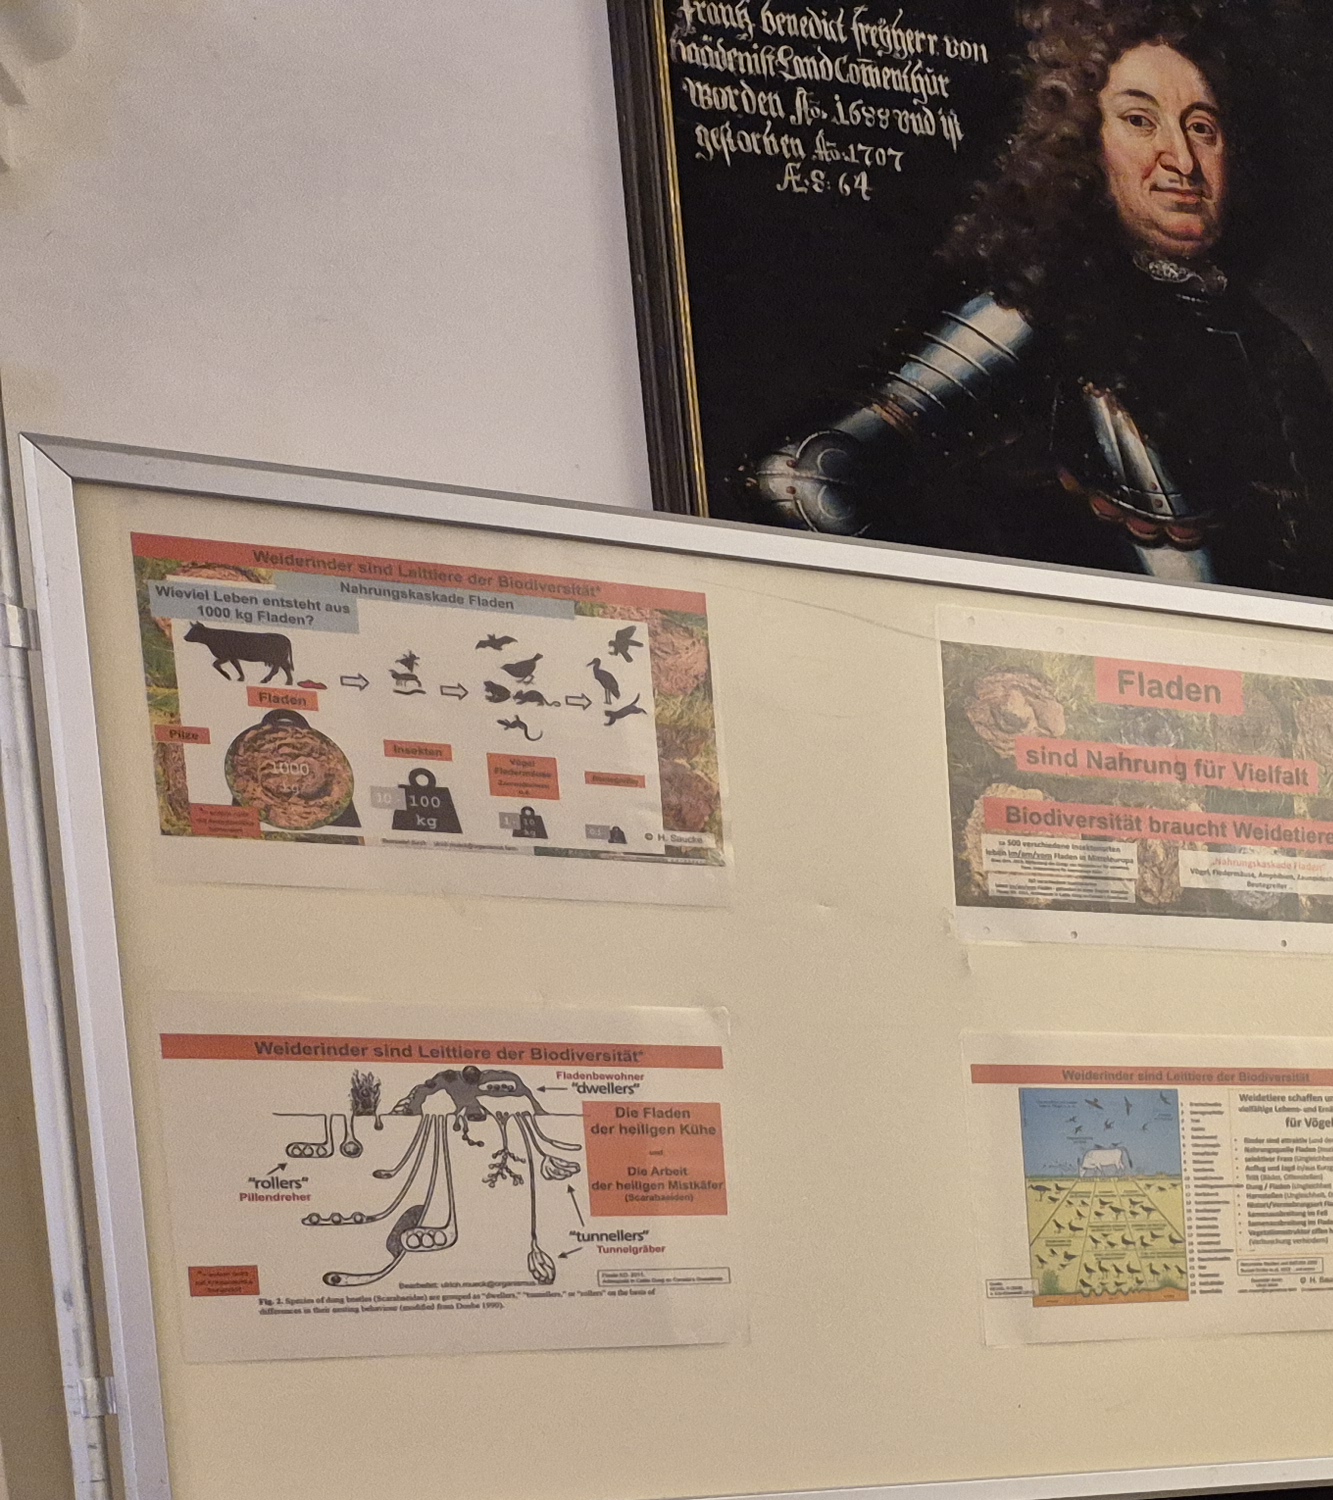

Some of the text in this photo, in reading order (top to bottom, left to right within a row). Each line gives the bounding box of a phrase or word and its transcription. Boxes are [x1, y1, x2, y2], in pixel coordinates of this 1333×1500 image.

[155, 585, 351, 614] Wieviel Leben entsteht aus
[340, 582, 515, 610] Nahrungskaskade Fladen
[196, 605, 315, 626] 1000 kg Fladen?
[1116, 669, 1222, 705] Fladen
[1026, 745, 1311, 788] sind Nahrung für Vielfalt
[409, 795, 441, 807] 100
[416, 814, 437, 829] kg
[1005, 805, 1143, 834] Biodiversität
[1148, 816, 1229, 839] braucht
[254, 1041, 527, 1062] Weiderinder sind Leittiere der
[555, 1071, 645, 1082] Fladenbewohner
[614, 1106, 692, 1120] Die Fladen
[1285, 1116, 1302, 1128] für
[590, 1122, 718, 1139] der heiligen Kühe
[239, 1191, 312, 1203] Pillendreher
